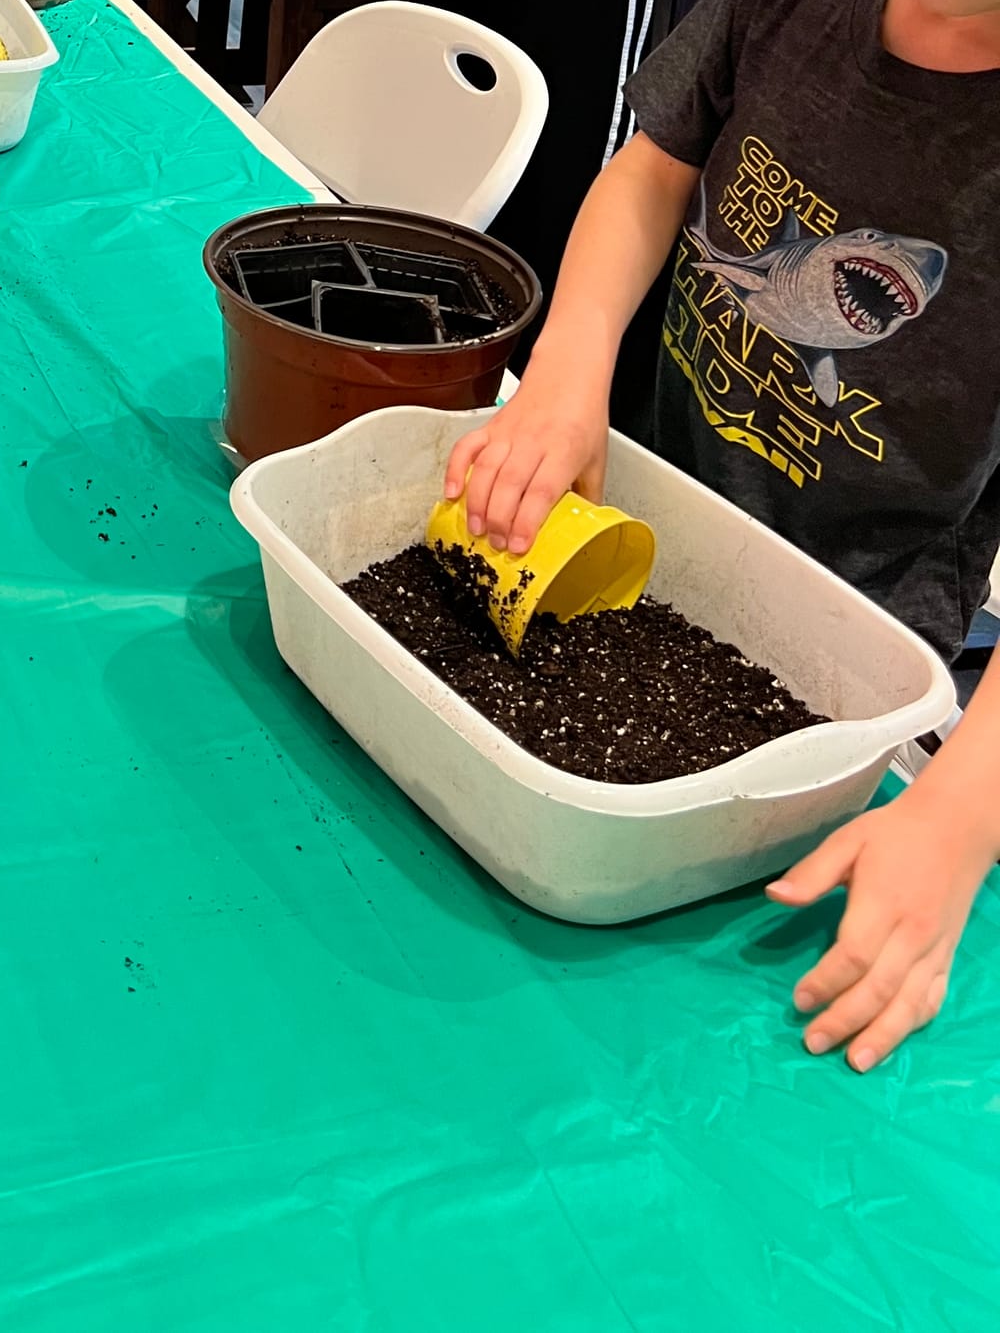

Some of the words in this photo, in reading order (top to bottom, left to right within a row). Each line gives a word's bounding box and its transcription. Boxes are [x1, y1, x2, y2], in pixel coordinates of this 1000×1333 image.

[718, 184, 770, 254] THE
[732, 162, 783, 227] TO
[741, 135, 839, 237] COME
